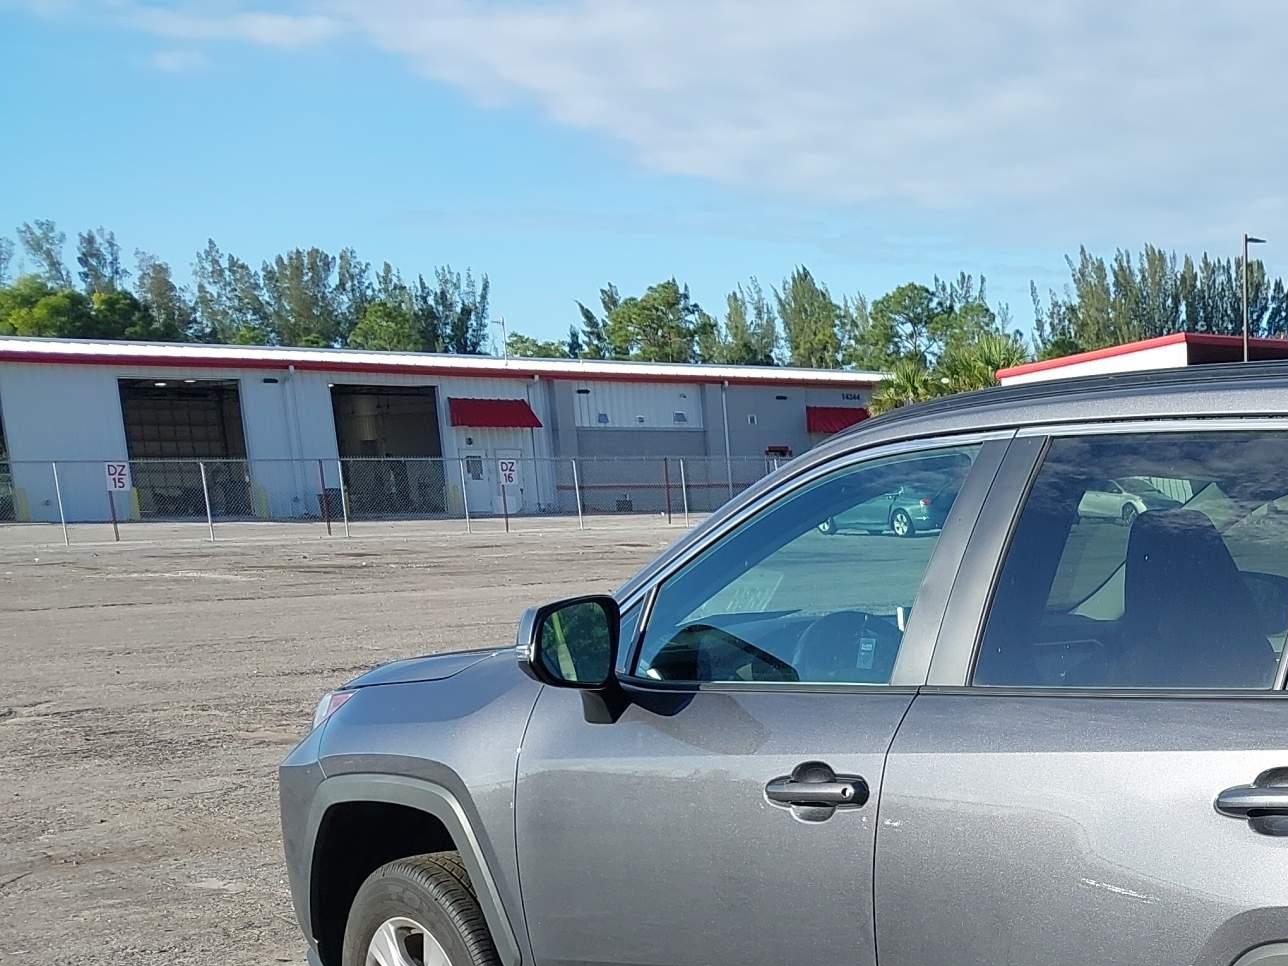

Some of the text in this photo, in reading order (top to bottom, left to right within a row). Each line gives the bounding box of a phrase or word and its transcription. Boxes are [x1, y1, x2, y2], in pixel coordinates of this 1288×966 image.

[107, 464, 127, 476] DZ
[500, 461, 515, 472] DZ
[112, 477, 126, 489] 15
[503, 473, 514, 483] 16
